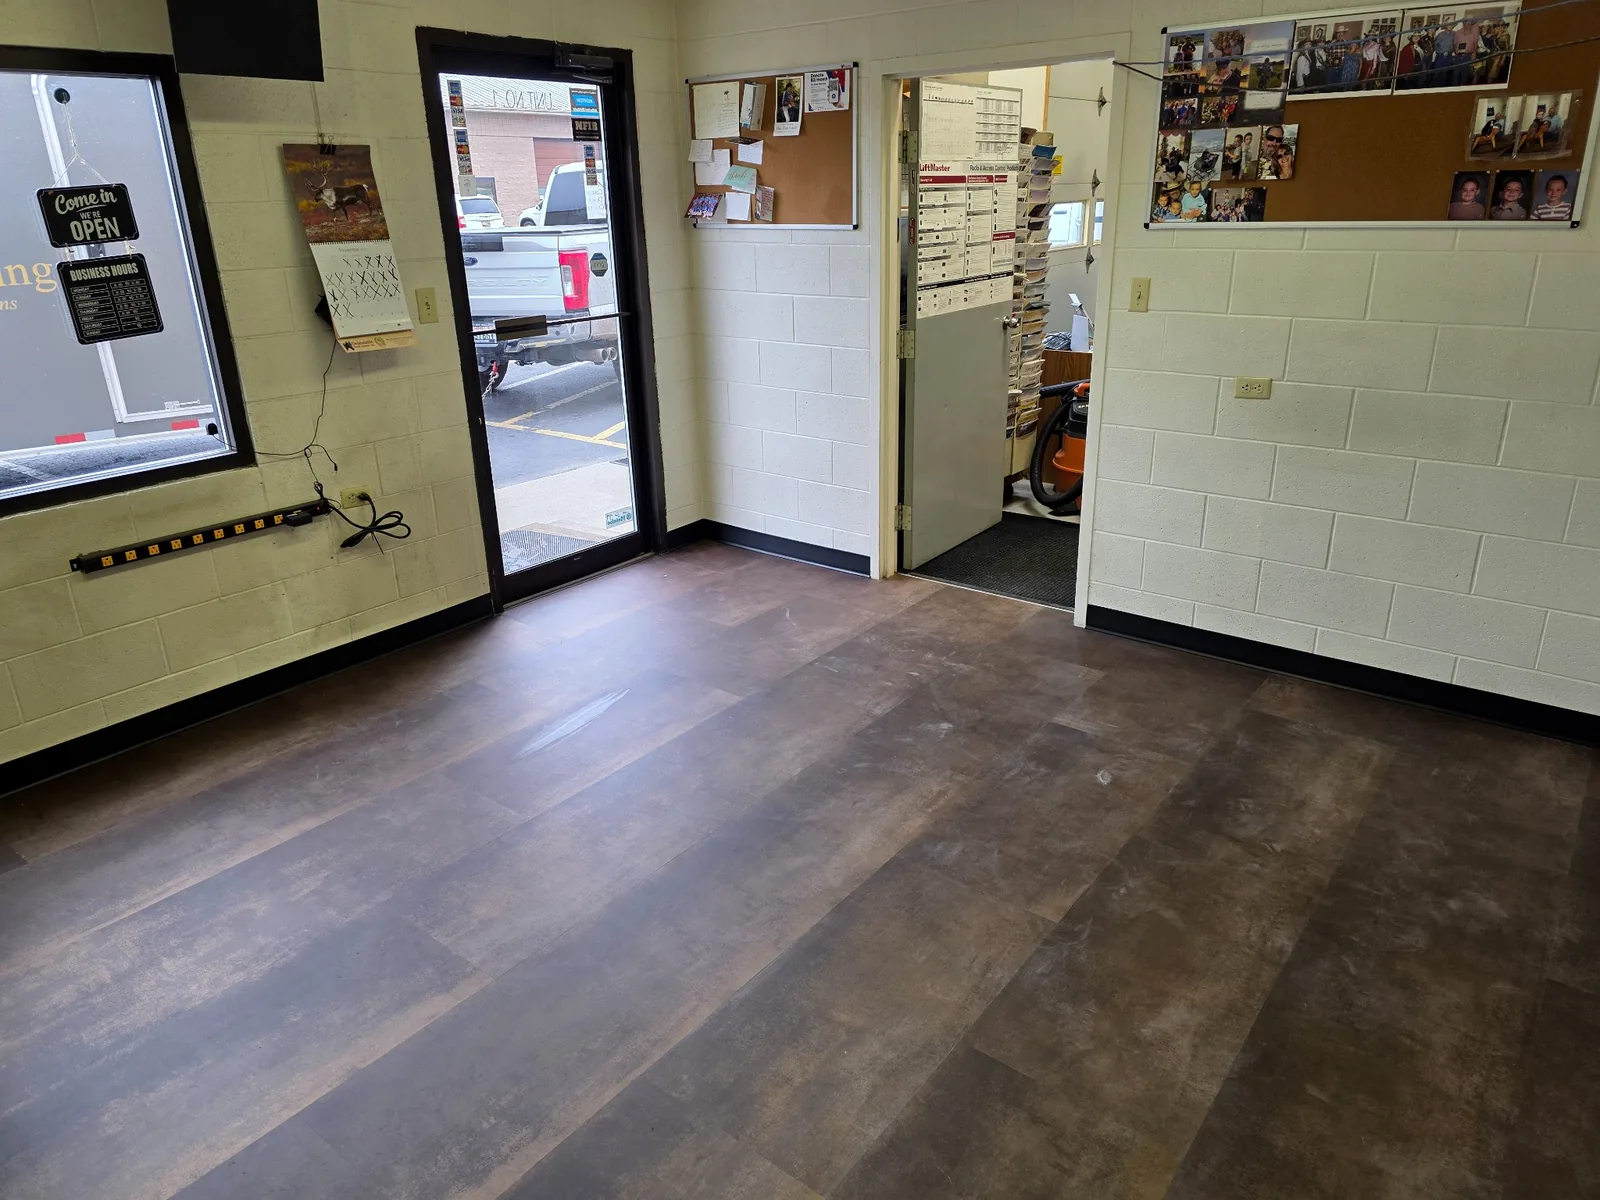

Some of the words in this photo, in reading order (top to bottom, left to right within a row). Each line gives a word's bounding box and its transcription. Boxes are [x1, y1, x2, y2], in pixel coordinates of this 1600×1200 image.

[919, 163, 950, 172] LiftMaster
[55, 193, 99, 215] Come
[99, 188, 118, 205] in
[79, 210, 101, 220] WE'RE
[70, 216, 121, 242] OPEN
[69, 266, 111, 282] BUSINESS
[111, 262, 139, 278] HOURS
